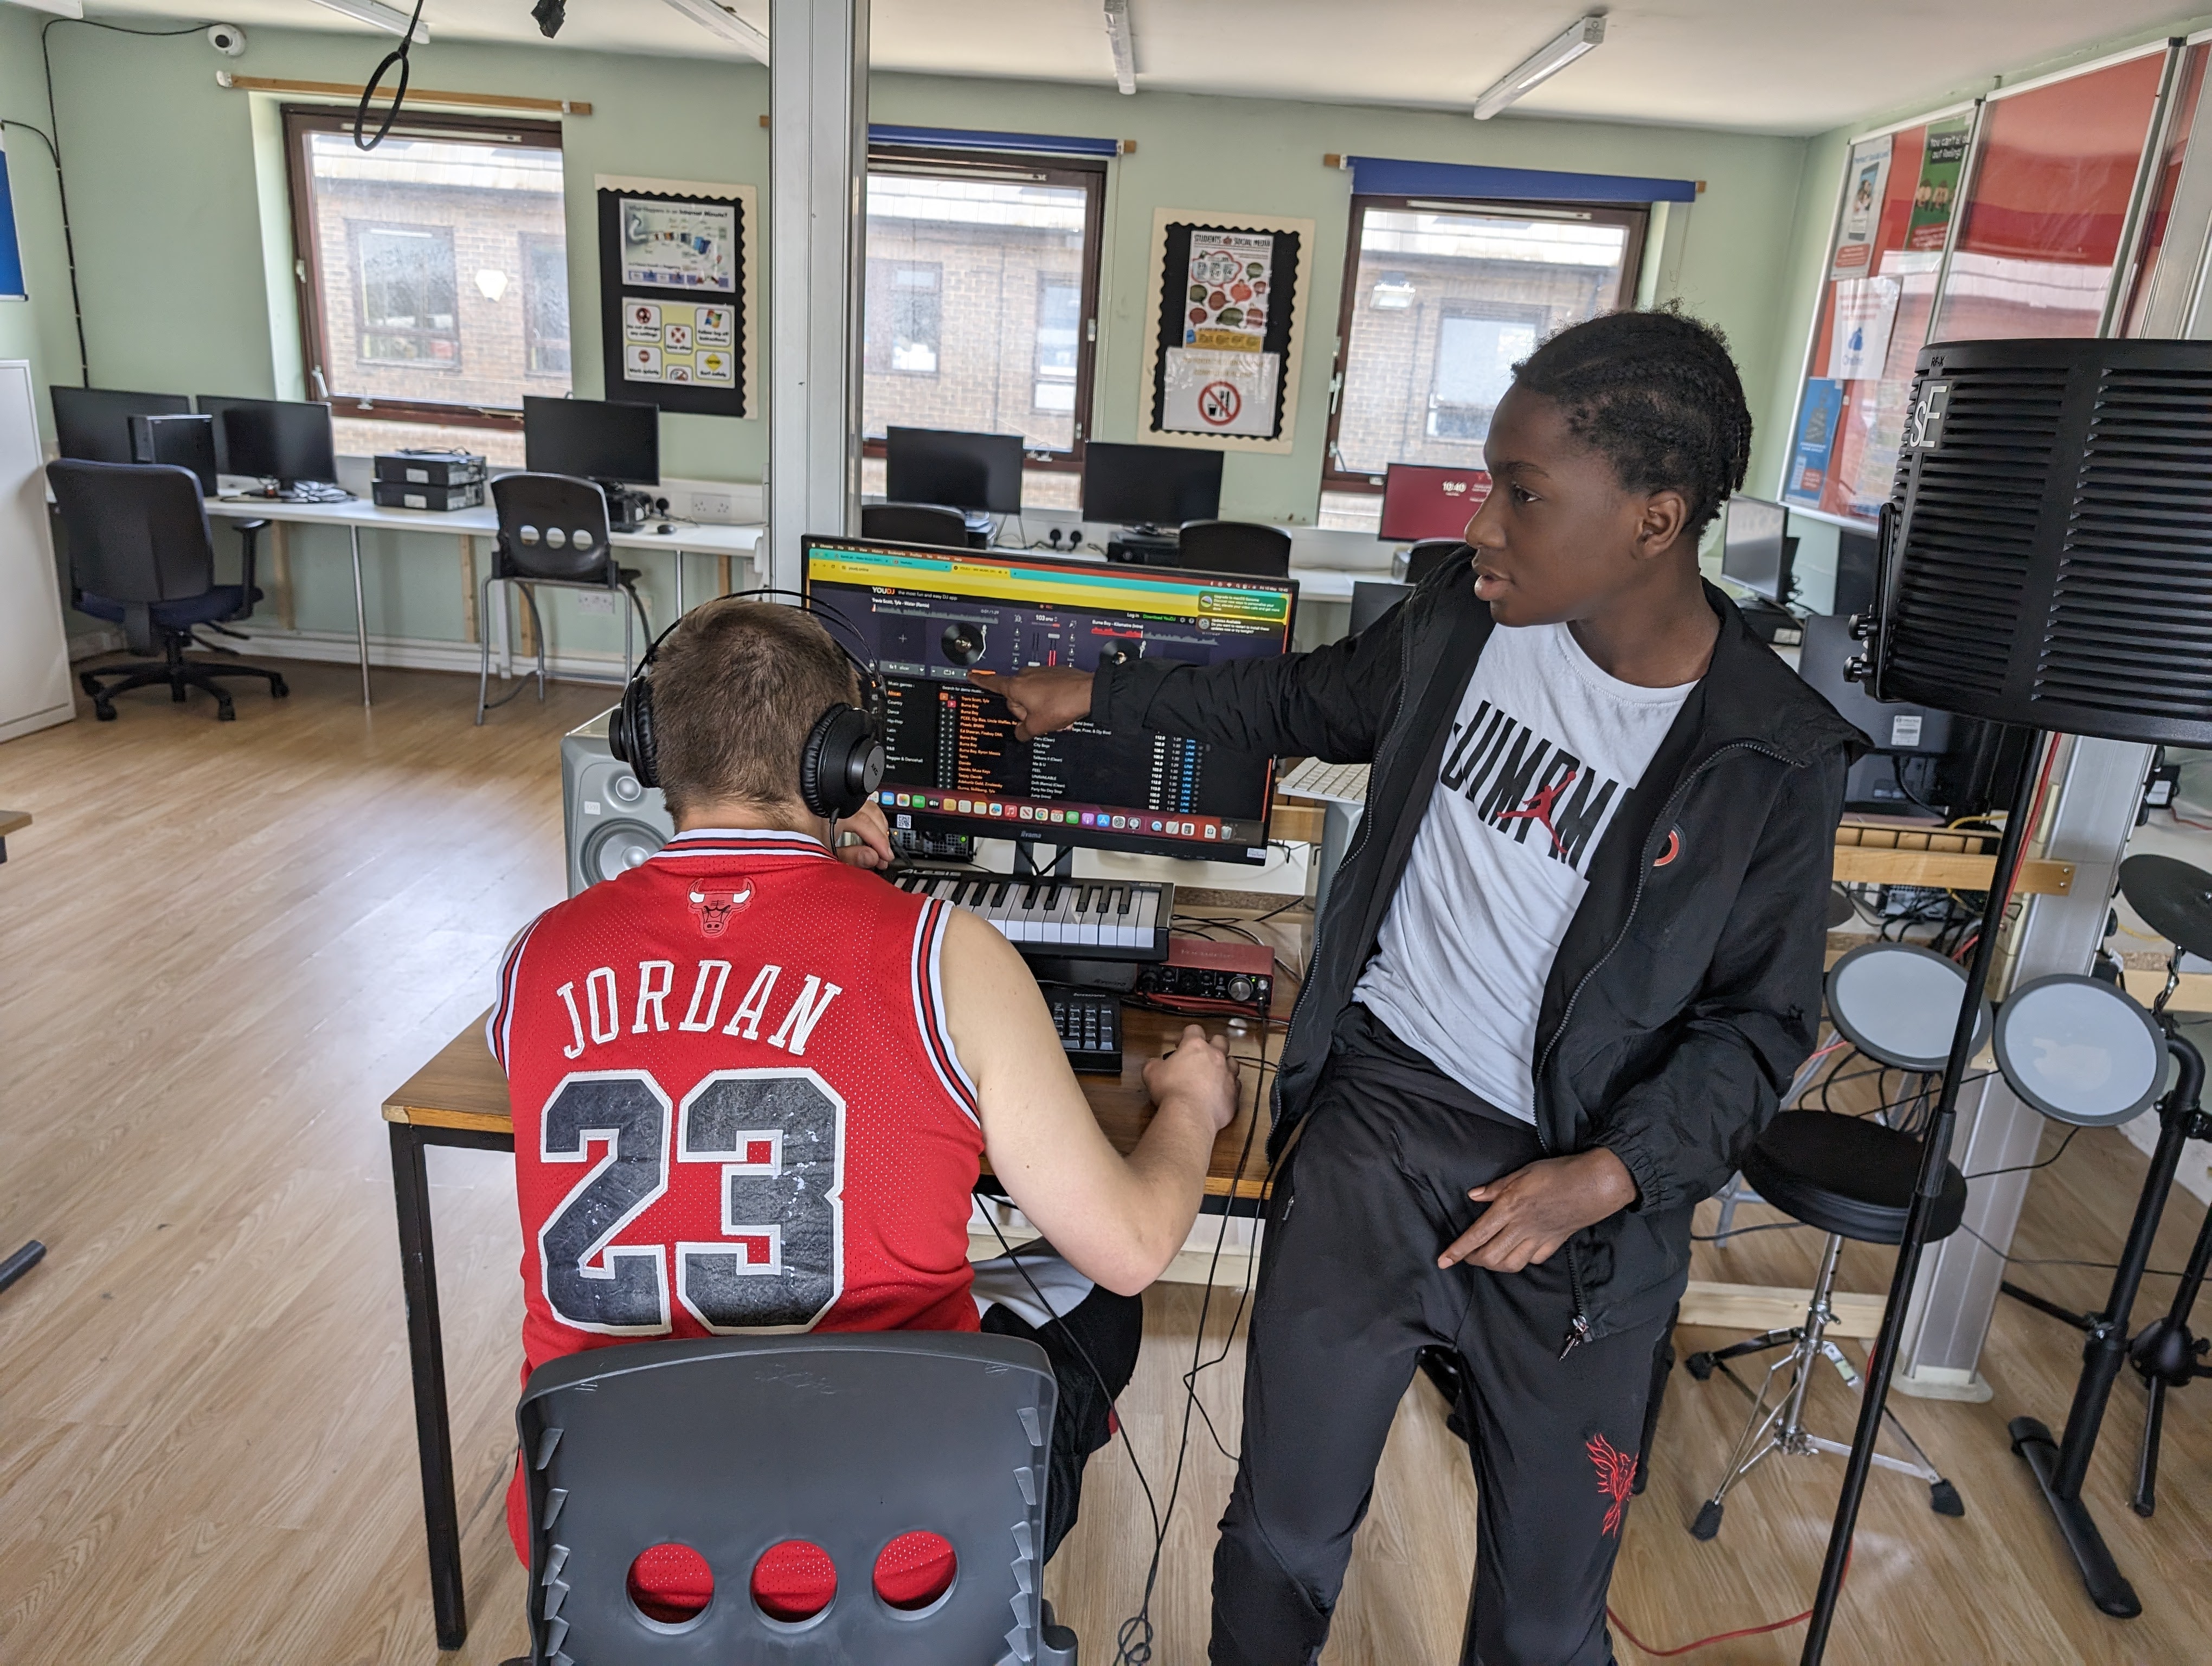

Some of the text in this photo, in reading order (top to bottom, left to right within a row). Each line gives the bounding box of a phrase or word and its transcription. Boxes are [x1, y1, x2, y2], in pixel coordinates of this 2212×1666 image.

[1443, 481, 1467, 492] 10:40
[872, 586, 895, 595] YOUDJ
[556, 959, 843, 1059] JORDAN
[538, 1066, 847, 1335] 23
